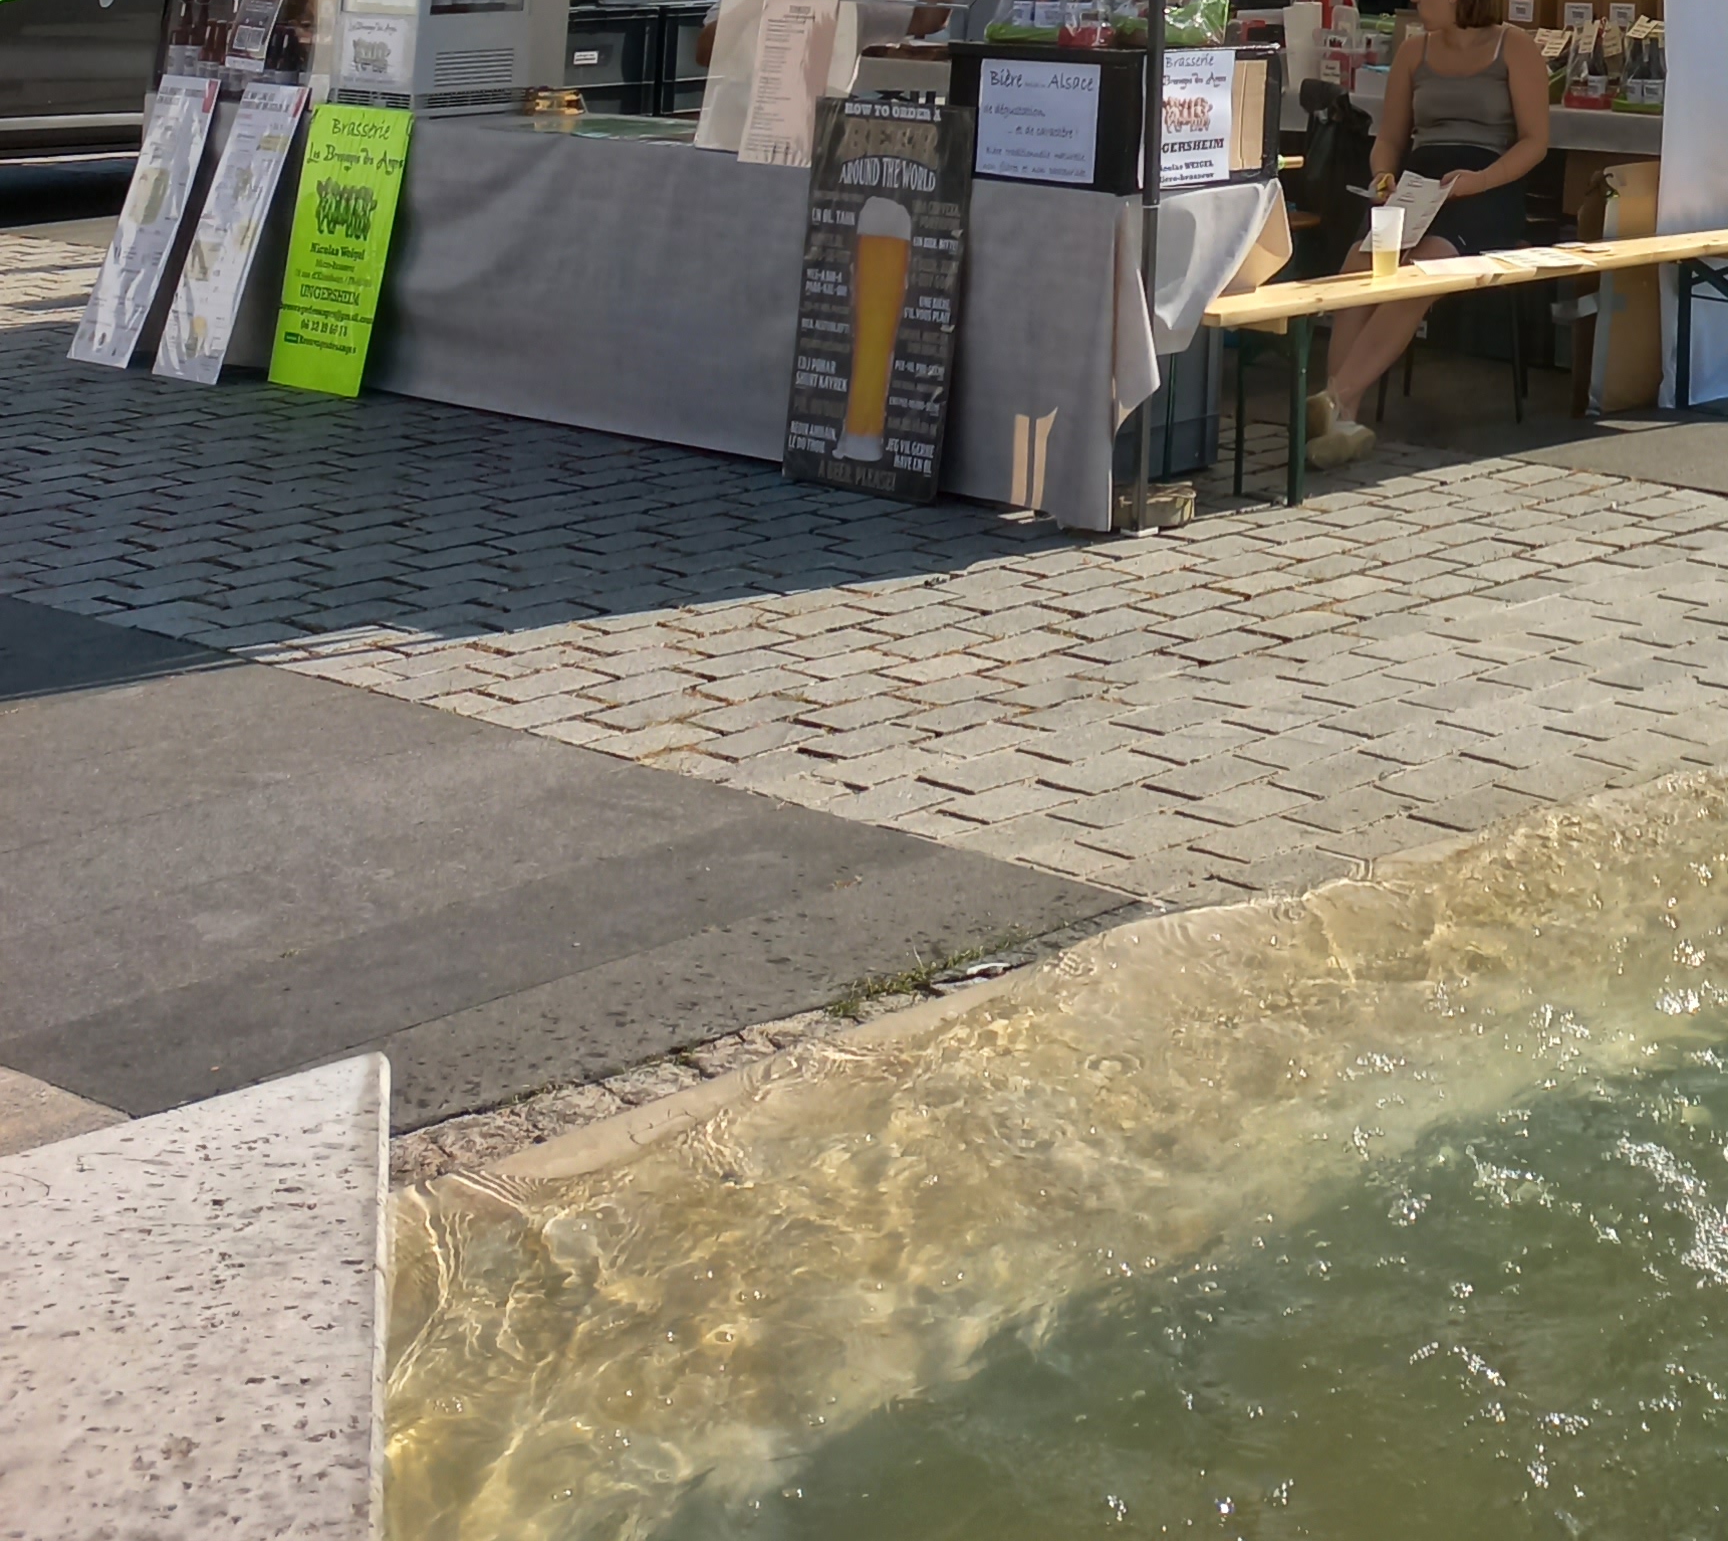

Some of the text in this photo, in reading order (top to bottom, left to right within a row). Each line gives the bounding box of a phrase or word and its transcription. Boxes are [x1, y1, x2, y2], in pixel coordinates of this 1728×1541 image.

[1165, 53, 1214, 68] Brasserie
[990, 68, 1093, 92] Bière Alsace
[845, 102, 872, 115] HOW
[874, 105, 890, 116] TO
[892, 106, 932, 121] ORDER
[331, 118, 391, 140] Brasserie
[1161, 138, 1225, 153] GERSHEIM
[839, 157, 936, 192] AROUND THE WORLD
[300, 283, 360, 306] UNGERSHEIM
